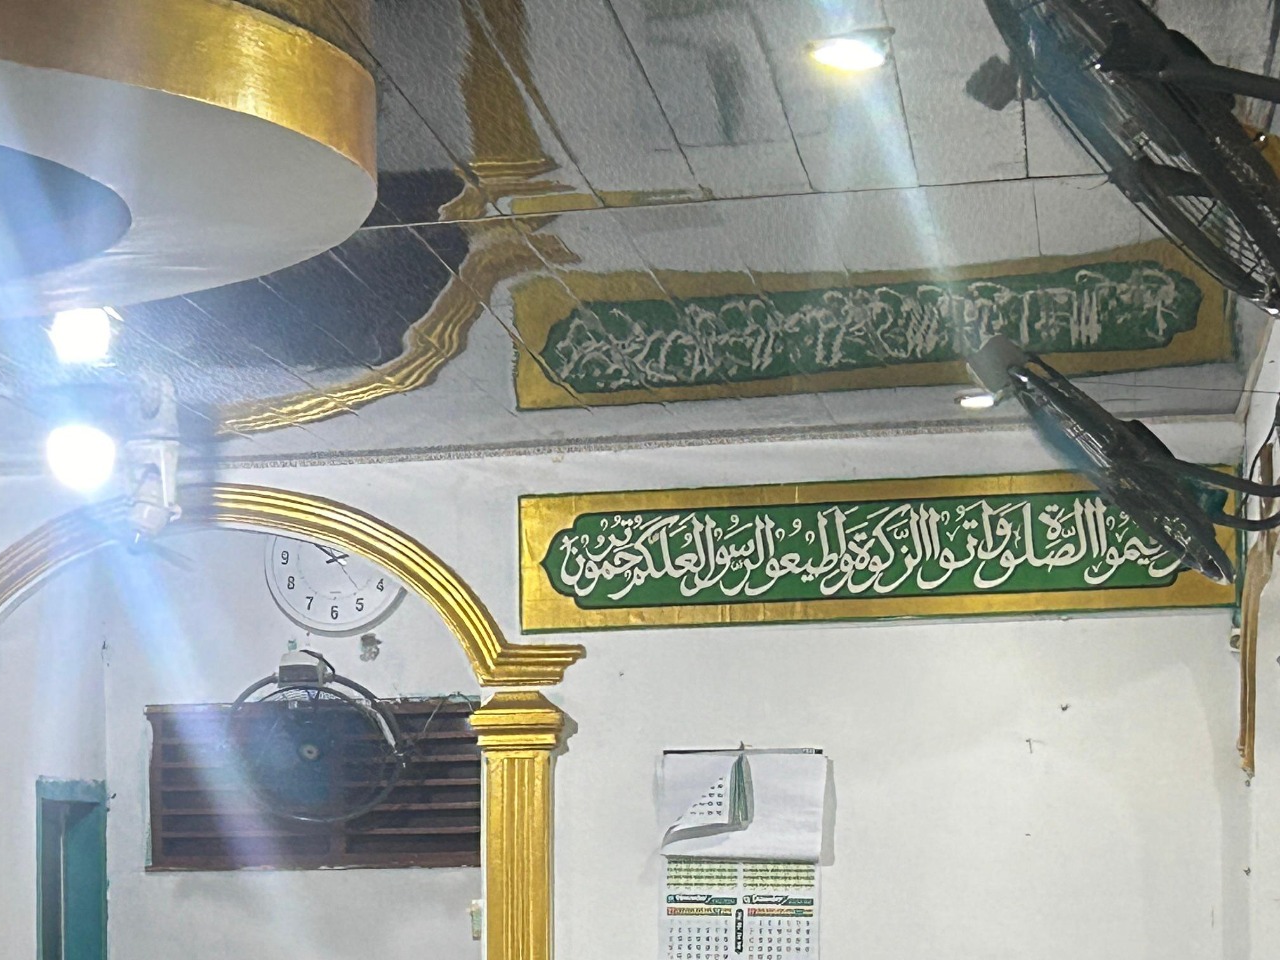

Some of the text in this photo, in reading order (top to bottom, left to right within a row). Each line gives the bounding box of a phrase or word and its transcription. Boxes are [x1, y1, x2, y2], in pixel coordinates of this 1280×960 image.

[280, 550, 290, 565] 9
[287, 576, 296, 590] 8
[305, 596, 314, 611] 7
[355, 597, 365, 612] 5
[330, 605, 339, 620] 6
